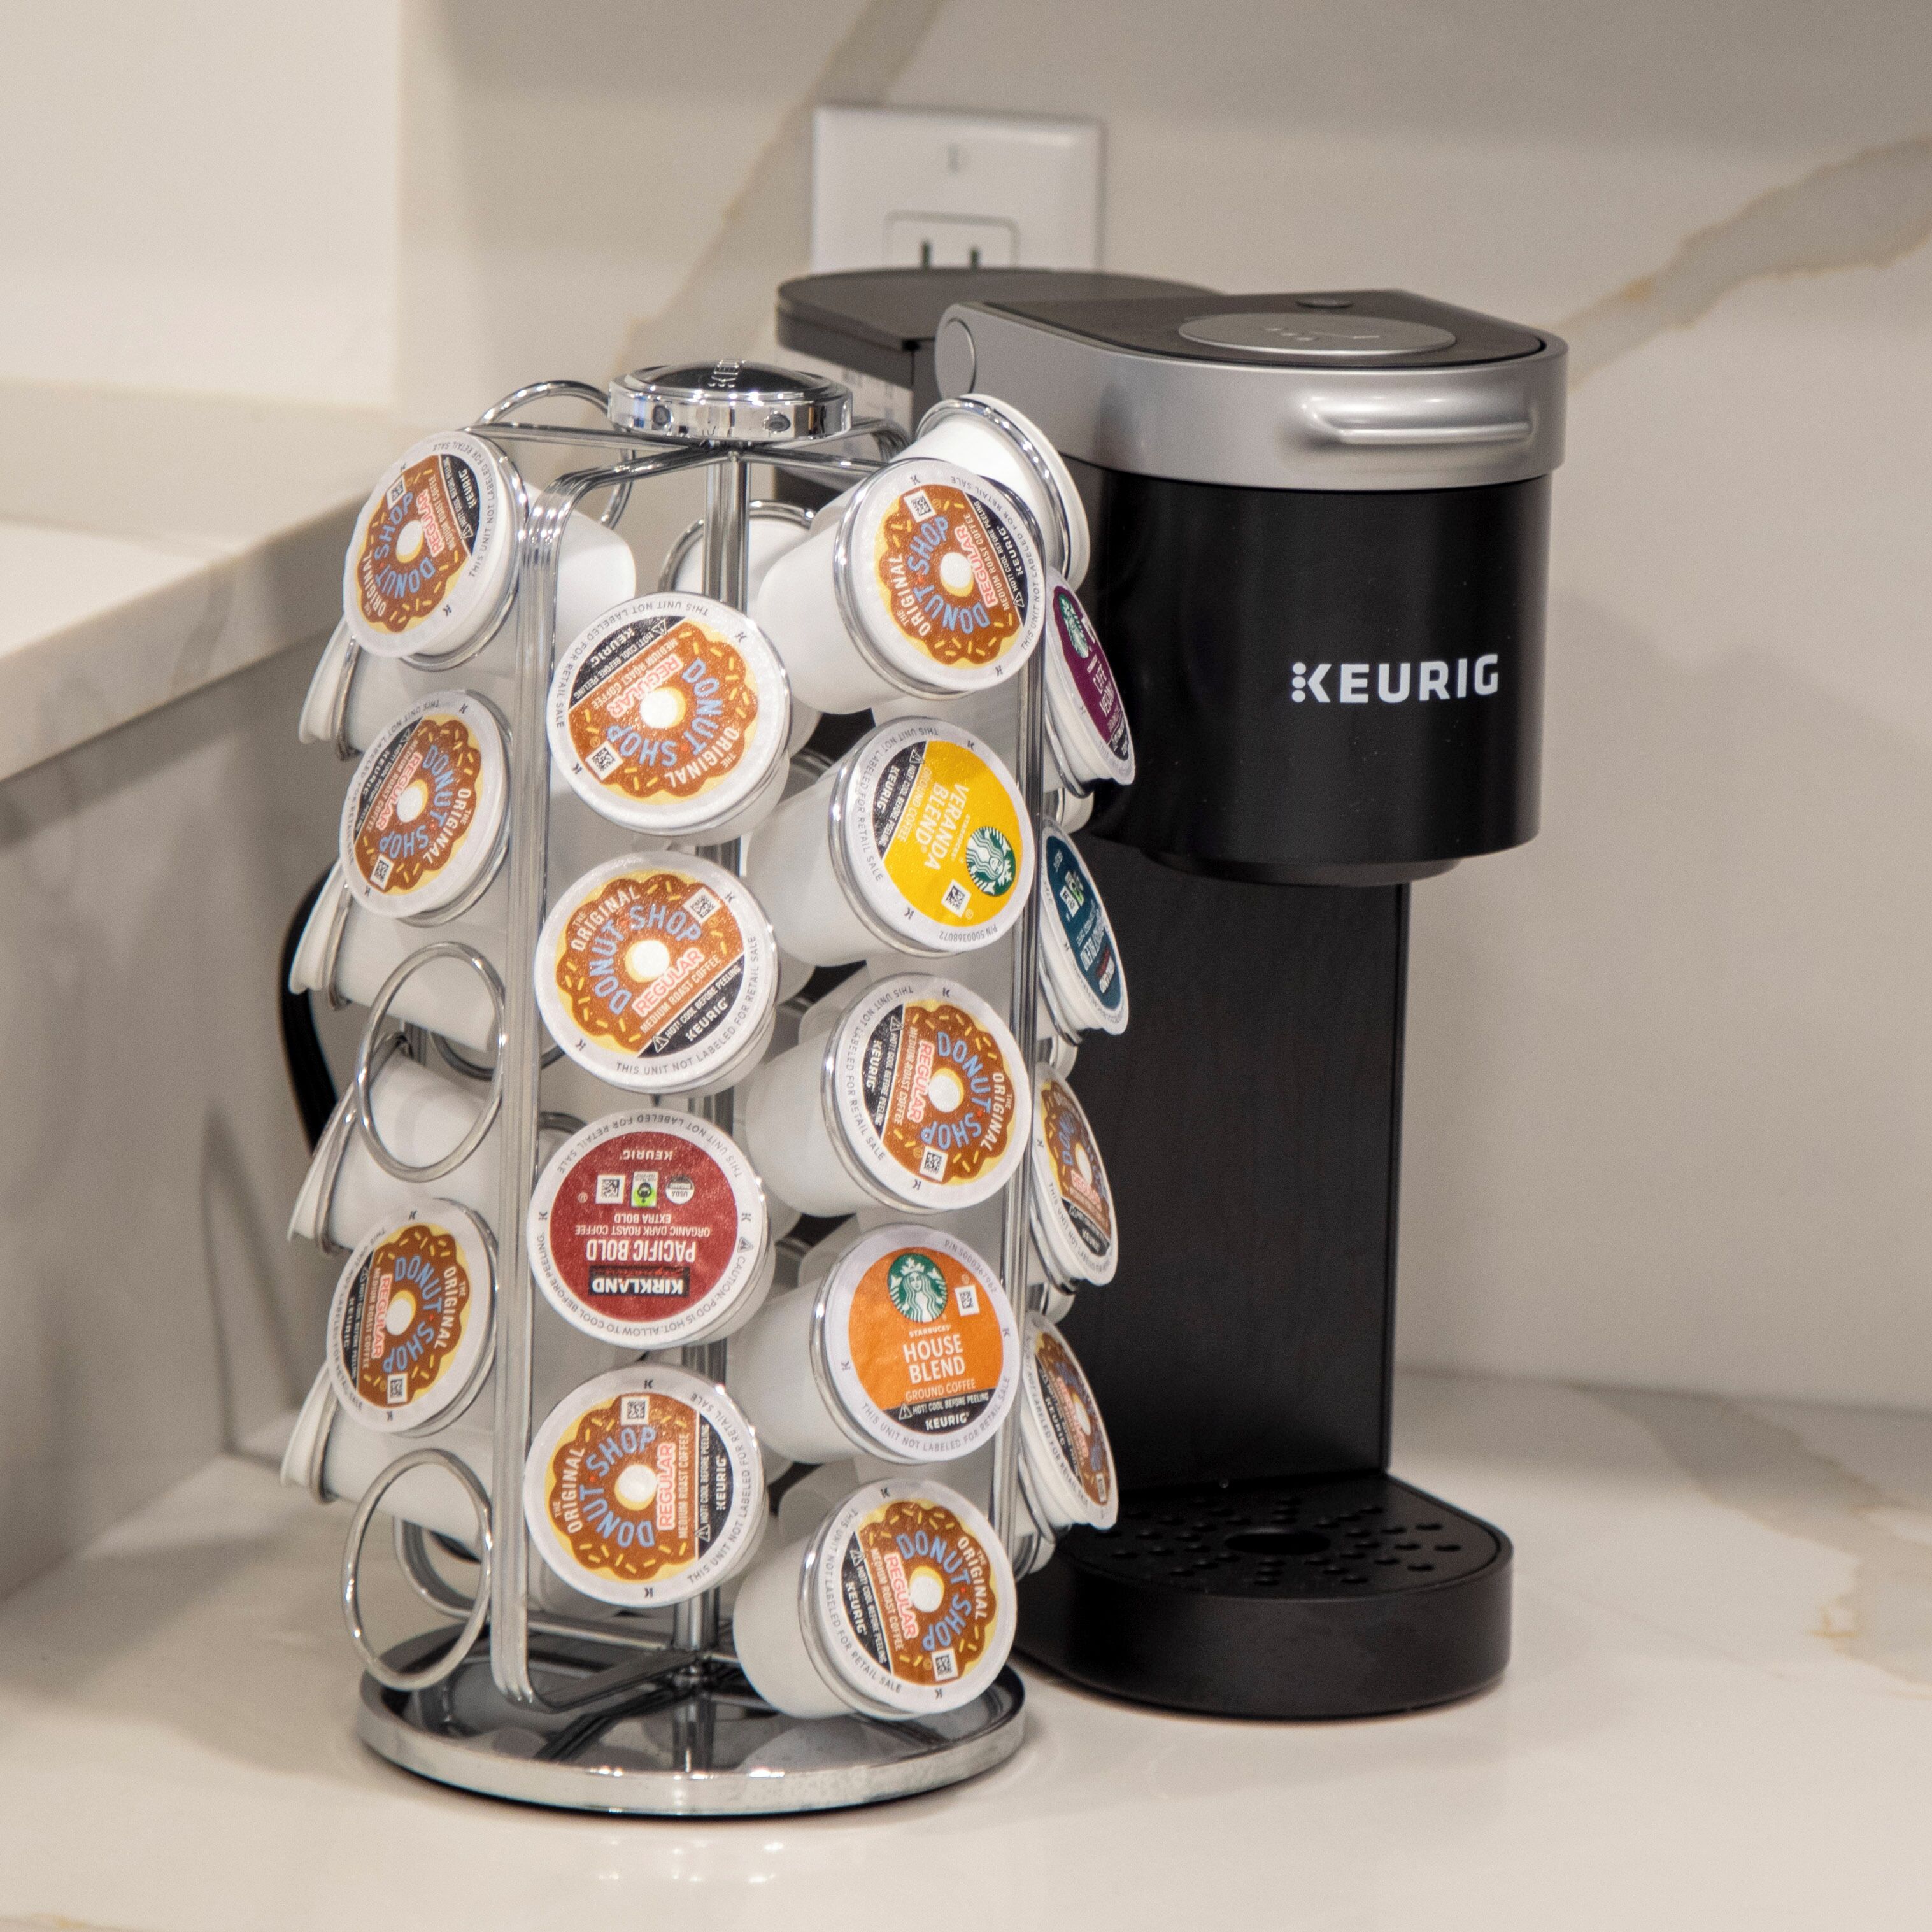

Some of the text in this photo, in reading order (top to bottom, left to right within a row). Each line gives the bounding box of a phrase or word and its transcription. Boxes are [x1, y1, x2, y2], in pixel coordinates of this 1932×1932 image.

[457, 469, 480, 508] KEURIG
[951, 476, 977, 488] SALE
[977, 487, 1002, 512] RETAIL
[374, 491, 436, 599] DONUT SHOP
[416, 489, 445, 557] REGULAR
[974, 501, 1018, 592] HOT! COOL BEFORE PEELING
[1002, 510, 1018, 530] FOR
[907, 516, 991, 634] DONUT SHOP
[955, 526, 997, 606] REGULAR
[963, 513, 1011, 611] MEDIUM ROAST COFFEE
[998, 527, 1024, 576] KEURIG
[1017, 531, 1039, 583] LABELED
[362, 550, 387, 618] ORIGINAL
[888, 554, 932, 636] ORIGINAL
[895, 609, 908, 627] THE
[1020, 629, 1035, 651] THIS
[1029, 606, 1039, 629] UNIT
[590, 627, 635, 666] KEURIG
[592, 638, 679, 710] MEDIUM ROAST COFFEE
[607, 655, 682, 718] REGULAR
[1292, 653, 1498, 703] KEURIG
[606, 658, 723, 767] DONUT SHOP
[900, 728, 916, 742] UNIT
[664, 723, 740, 788] ORIGINAL
[720, 753, 736, 769] THE
[860, 750, 883, 790] LABELED
[881, 737, 897, 755] NOT
[376, 751, 423, 831] REGULAR
[379, 744, 455, 860] DONUT SHOP
[877, 765, 900, 813] KEURIG
[897, 767, 932, 842] GROUND COFFEE
[916, 782, 949, 846] BLEND
[423, 787, 472, 864] ORIGINAL
[460, 810, 472, 825] THE
[858, 816, 868, 853] RETAIL
[925, 783, 970, 870] VERANDA
[866, 855, 883, 882] SALE
[570, 885, 641, 952] ORIGINAL
[573, 909, 586, 927] THE
[589, 902, 702, 1015] DONUT SHOP
[634, 948, 704, 1016] REGULAR
[616, 935, 760, 1075] THIS UNIT NOT LABELED FOR RETAIL SALE
[640, 954, 721, 1033] MEDIUM ROAST COFFEE
[665, 965, 741, 1039] HOT! COOL BEFORE PEELING
[685, 998, 728, 1041] KEURIG
[866, 1039, 883, 1090] KEURIG
[907, 1040, 934, 1123] REGULAR
[920, 1031, 992, 1150] DONUT SHOP
[980, 1072, 1007, 1151] ORIGINAL
[557, 1114, 744, 1177] THIS UNIT NOT LABELED FOR RETAIL SALE
[623, 1150, 673, 1161] KEURIG
[575, 1225, 711, 1237] ORGANIC DARK ROAST COFFEE
[614, 1213, 671, 1223] EXTRA BOLD
[586, 1239, 697, 1263] PACIFIC BOLD
[434, 1265, 457, 1349] ORIGINAL
[458, 1281, 467, 1298] THE
[550, 1280, 578, 1312] BEFORE
[592, 1277, 683, 1295] KIRKLAND
[697, 1300, 716, 1318] POD
[371, 1274, 392, 1359] REGULAR
[382, 1256, 443, 1374] DONUT SHOP
[579, 1309, 604, 1328] COOL
[606, 1324, 620, 1334] TO
[622, 1326, 659, 1337] ALLOW
[685, 1314, 697, 1323] IS
[902, 1333, 963, 1363] HOUSE
[909, 1356, 965, 1384] BLEND
[862, 1376, 1010, 1453] THIS UNIT NOT LABELED FOR RETAIL SALE
[906, 1378, 976, 1402] GROUND COFFEE
[928, 1400, 944, 1412] COOL
[944, 1396, 966, 1409] BEFORE
[925, 1412, 967, 1431] KEURIG
[560, 1446, 586, 1534] ORIGINAL
[579, 1426, 657, 1548] DONUT SHOP
[657, 1443, 675, 1530] REGULAR
[716, 1455, 727, 1511] KEURIG
[884, 1552, 919, 1640] REGULAR
[896, 1530, 972, 1651] DONUT SHOP
[956, 1537, 988, 1621] ORIGINAL
[846, 1581, 867, 1635] KEURIG
